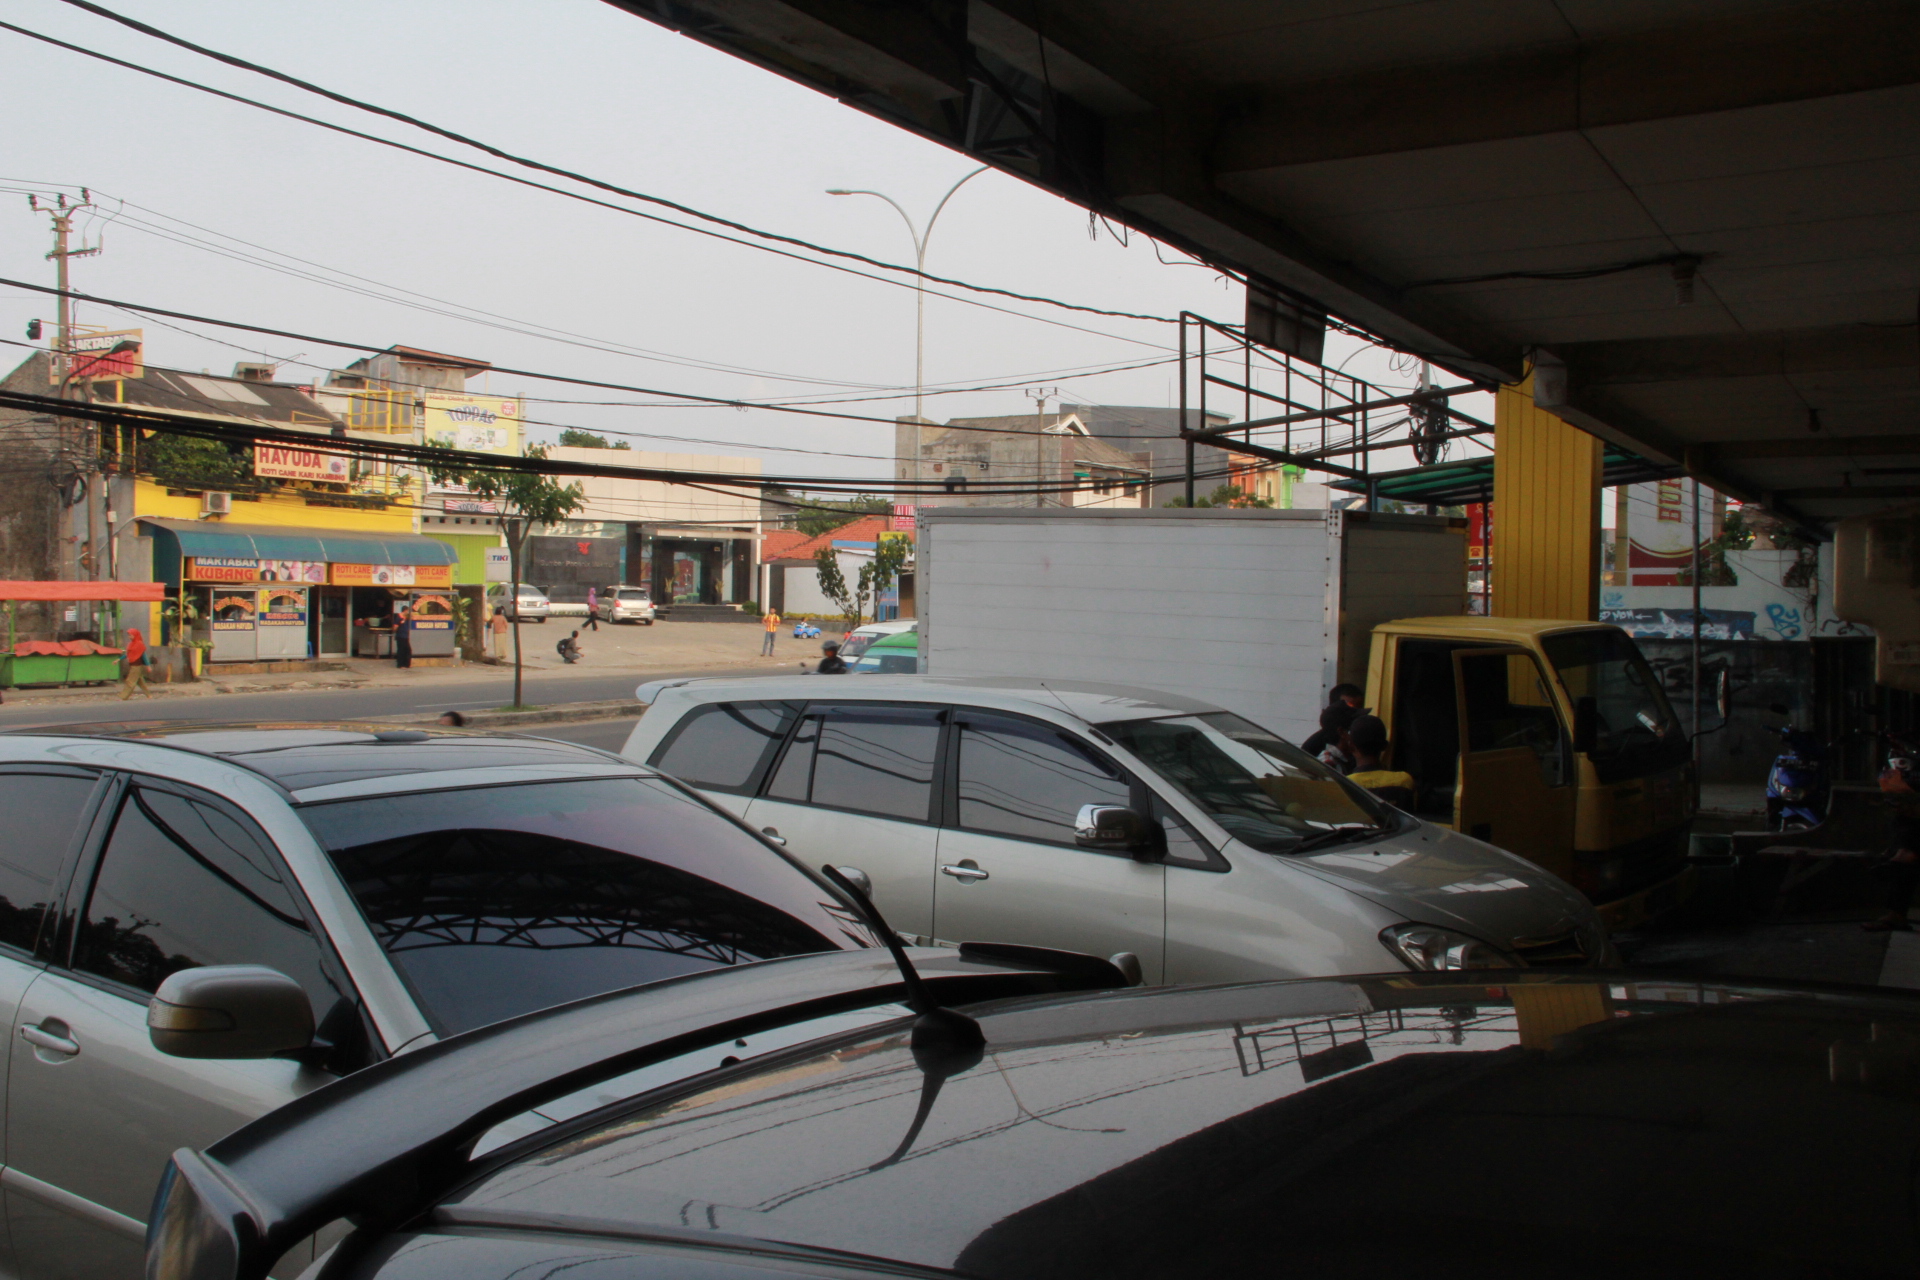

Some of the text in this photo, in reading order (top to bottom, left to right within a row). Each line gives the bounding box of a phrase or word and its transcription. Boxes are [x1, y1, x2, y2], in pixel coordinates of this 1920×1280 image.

[259, 446, 322, 469] HAYUDA
[279, 469, 296, 477] CANE
[299, 471, 314, 479] KARI
[316, 473, 345, 481] KAMBING
[196, 567, 254, 580] KUBANG
[336, 565, 371, 574] ROTI CANE
[416, 567, 430, 575] ROTI
[236, 622, 254, 630] HAYUDA
